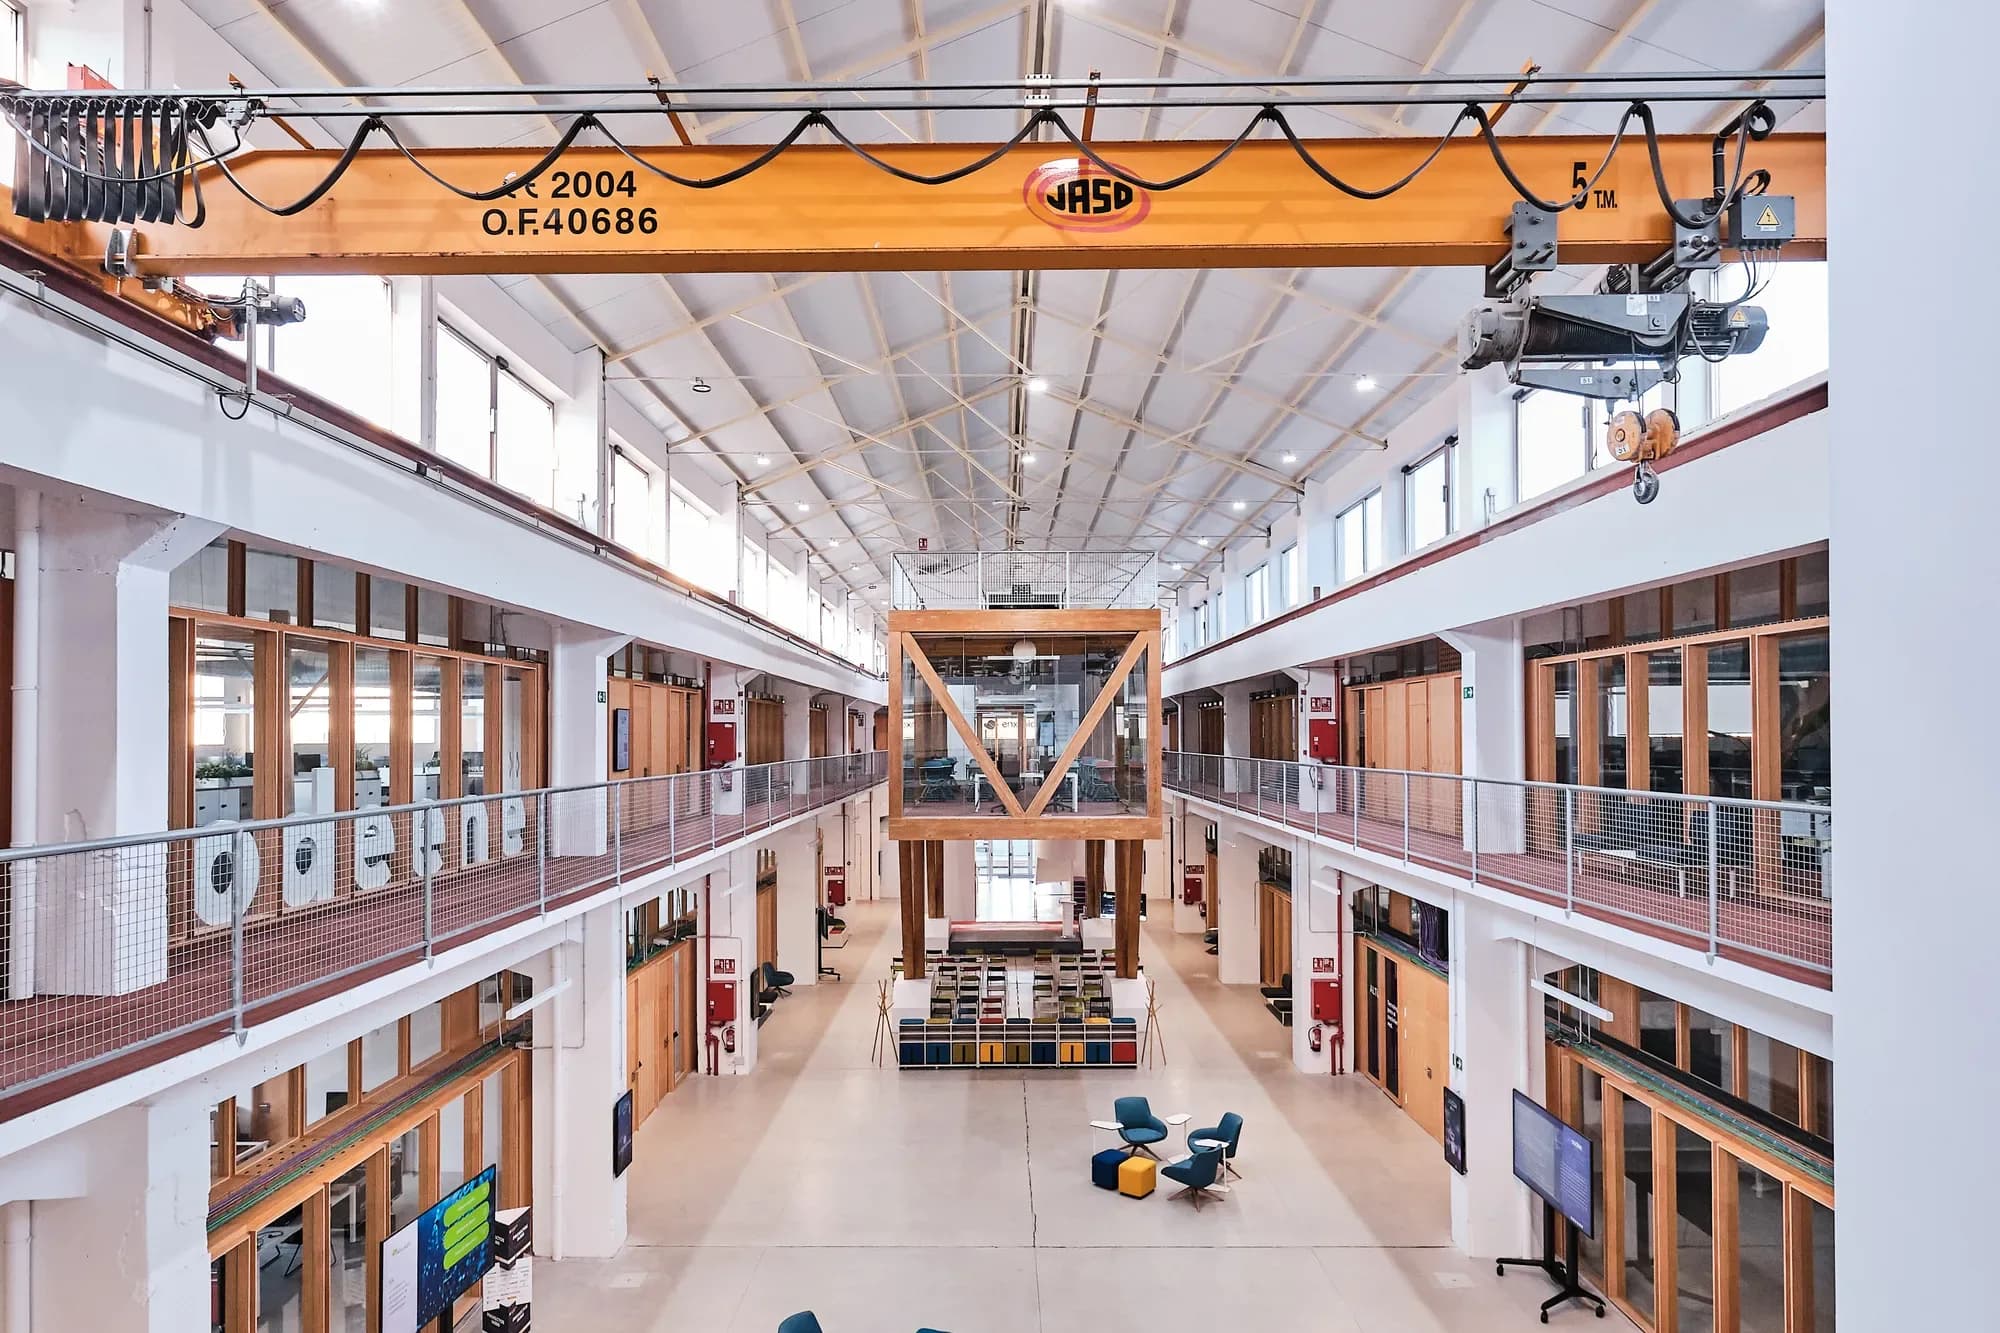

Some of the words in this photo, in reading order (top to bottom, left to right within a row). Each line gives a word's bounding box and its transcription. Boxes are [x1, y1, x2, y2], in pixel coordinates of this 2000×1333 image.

[551, 171, 637, 198] 2004
[1046, 179, 1134, 214] JASO
[1572, 162, 1588, 210] 5
[1593, 190, 1618, 208] T.M.
[482, 207, 658, 236] O.F.40686
